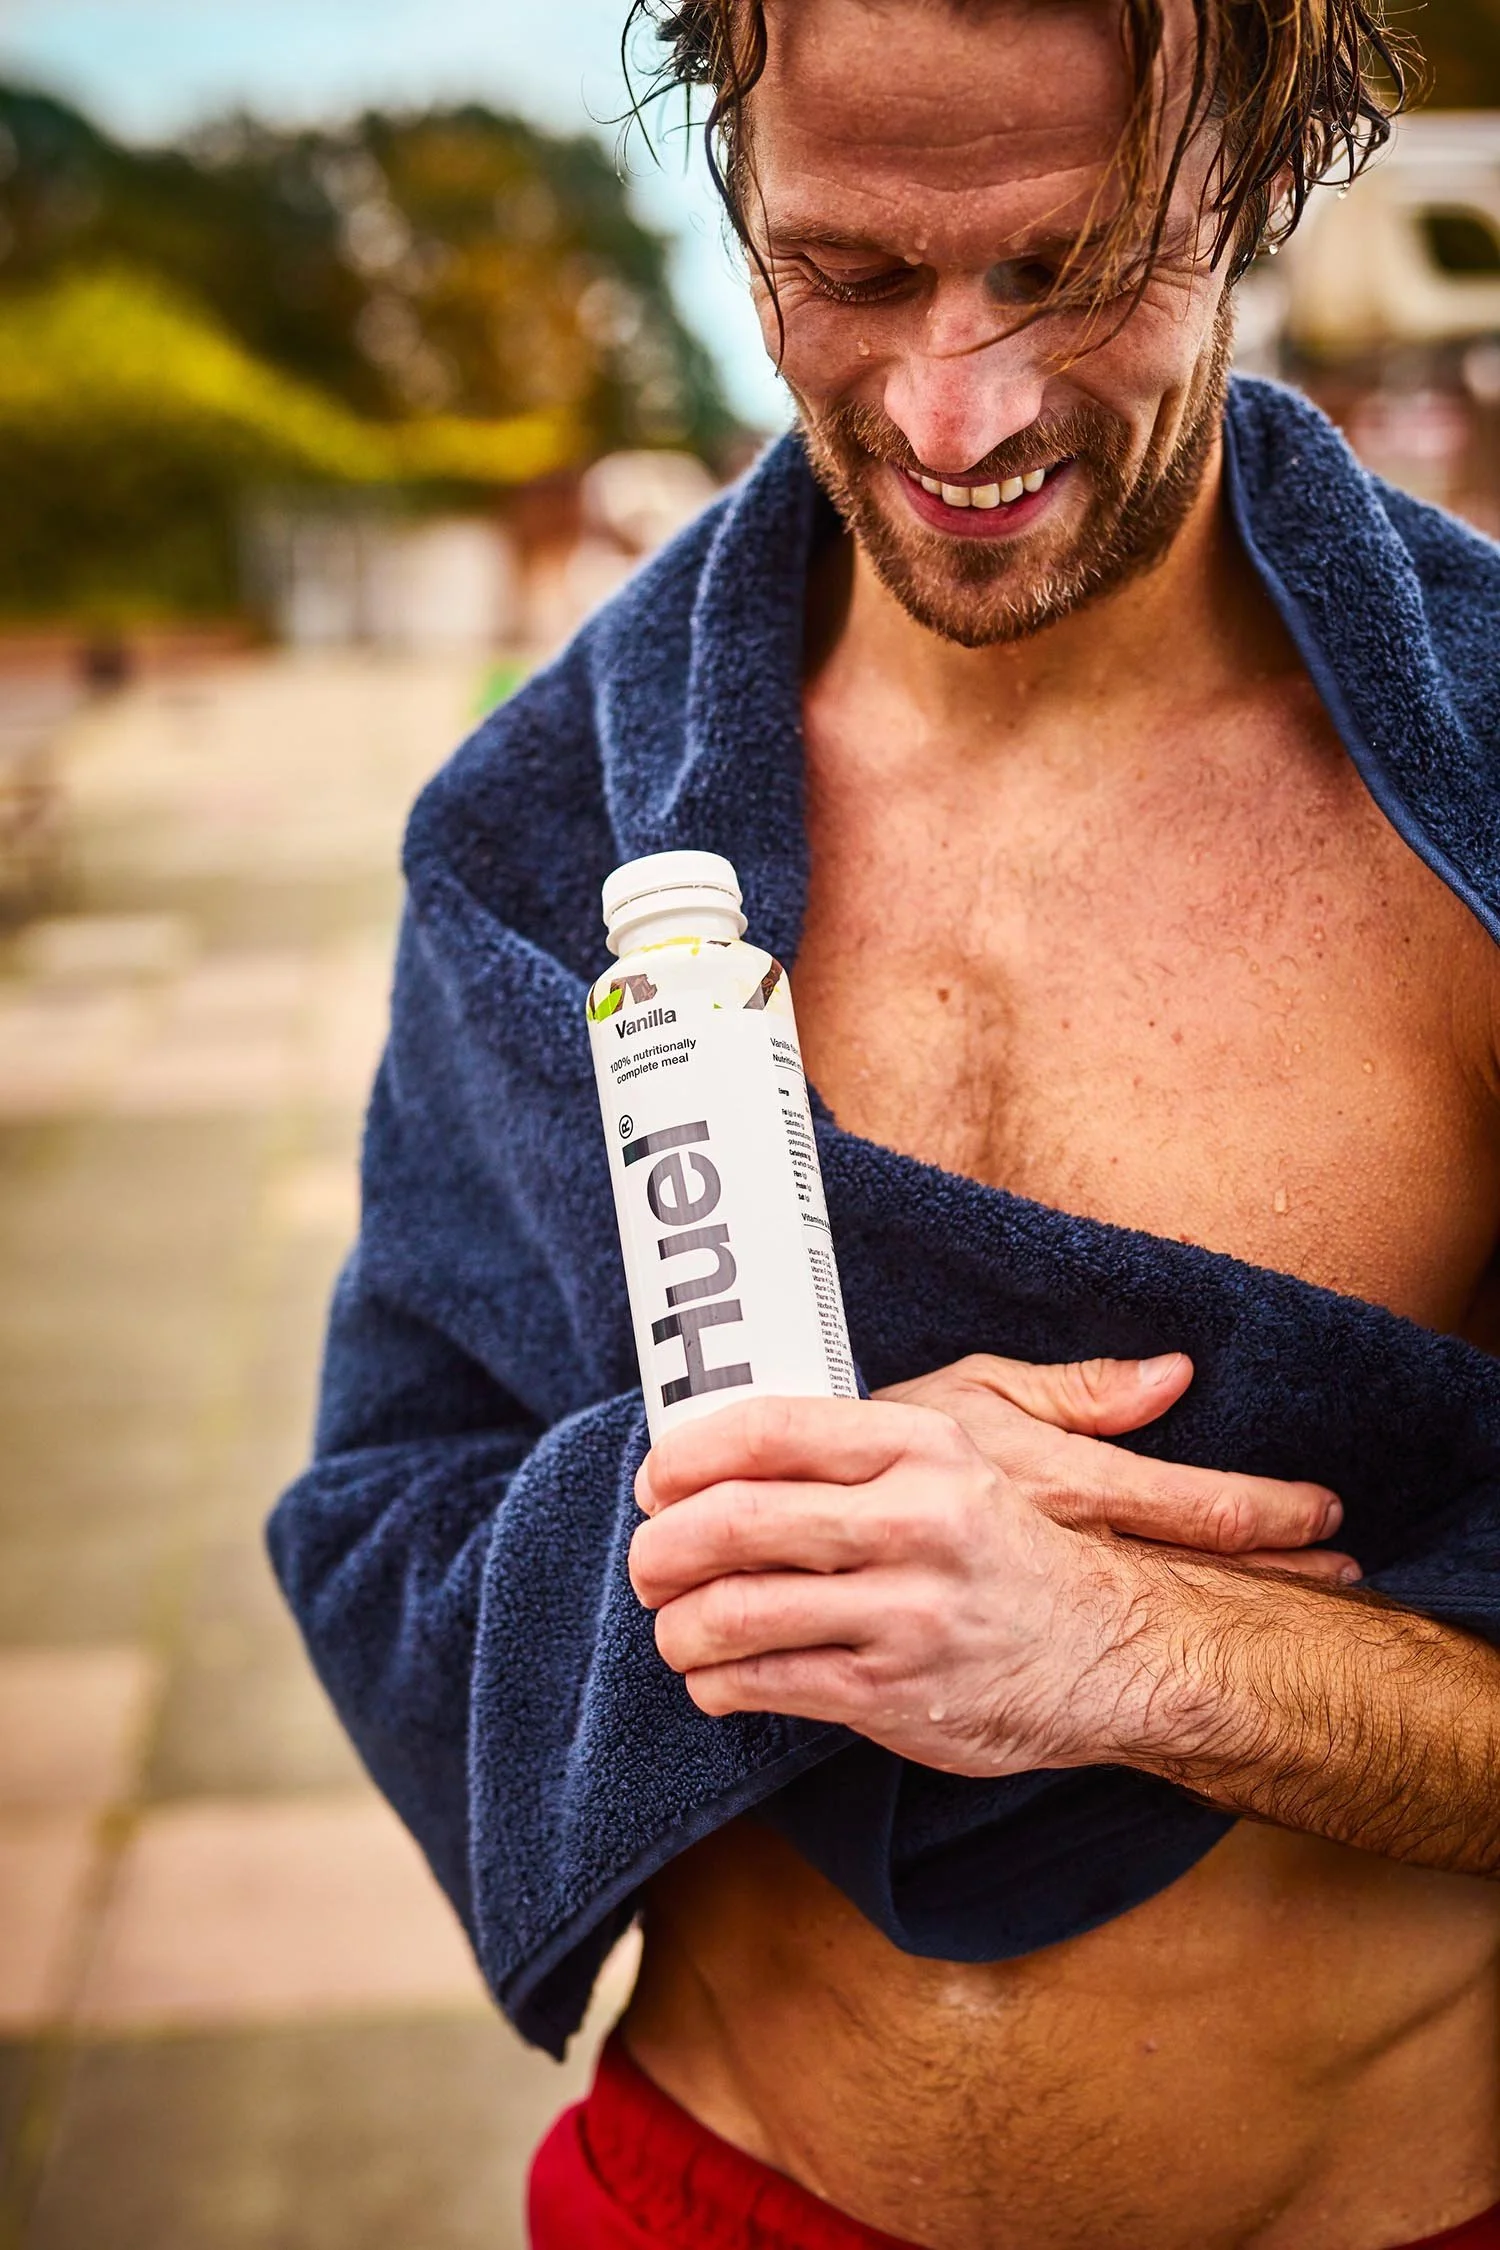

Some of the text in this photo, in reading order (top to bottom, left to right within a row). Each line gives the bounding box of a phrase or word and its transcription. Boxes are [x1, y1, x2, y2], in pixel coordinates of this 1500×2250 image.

[615, 1008, 677, 1039] Vanilla
[610, 1038, 697, 1073] 100% nutritionally
[616, 1052, 689, 1084] complete meal
